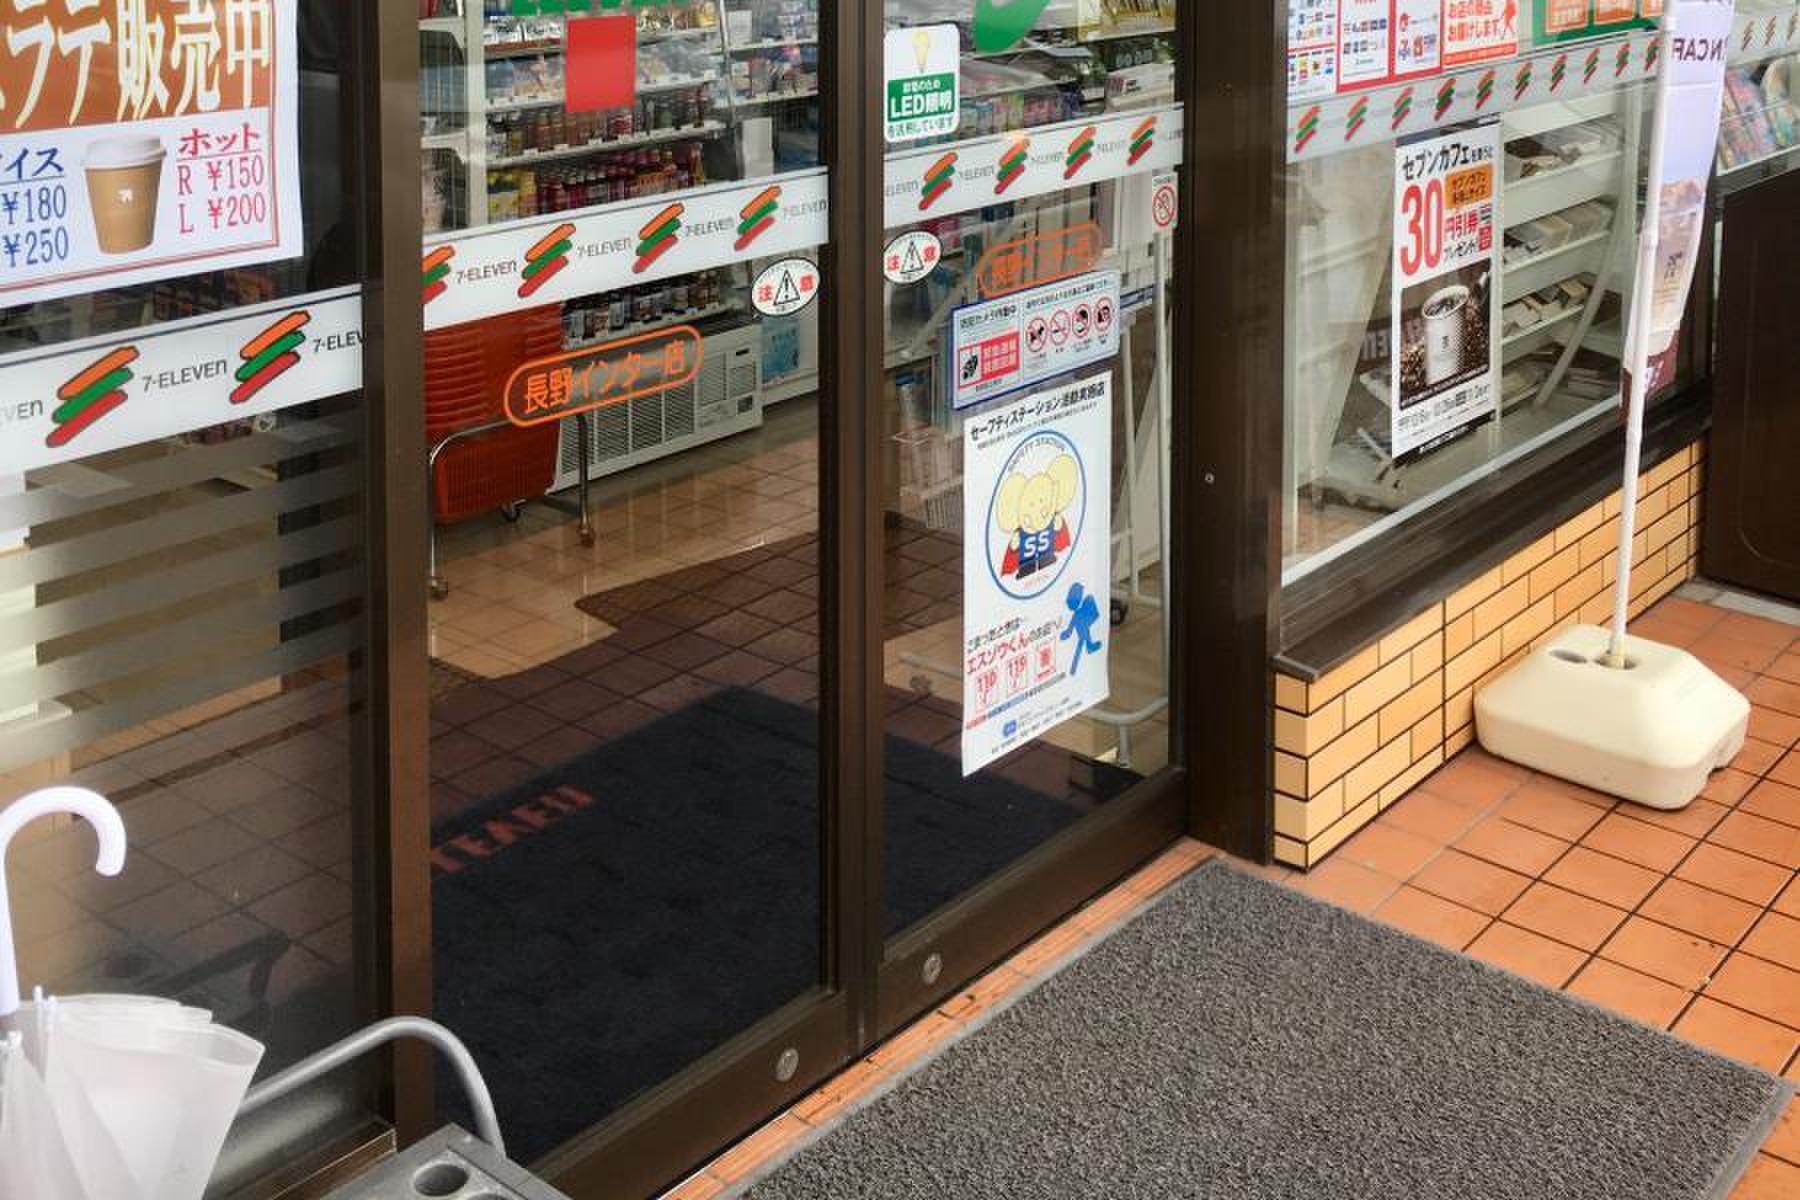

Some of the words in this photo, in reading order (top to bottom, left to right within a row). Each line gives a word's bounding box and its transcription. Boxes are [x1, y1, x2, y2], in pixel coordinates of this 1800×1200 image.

[178, 123, 261, 157] ホット
[0, 147, 64, 180] イス
[178, 165, 192, 196] R
[208, 155, 265, 191] ¥150
[2, 185, 67, 226] ¥180
[179, 203, 194, 234] L
[208, 191, 266, 229] ¥200
[3, 225, 69, 269] ¥250
[1401, 178, 1443, 276] 30
[524, 339, 686, 415] 長野インター店
